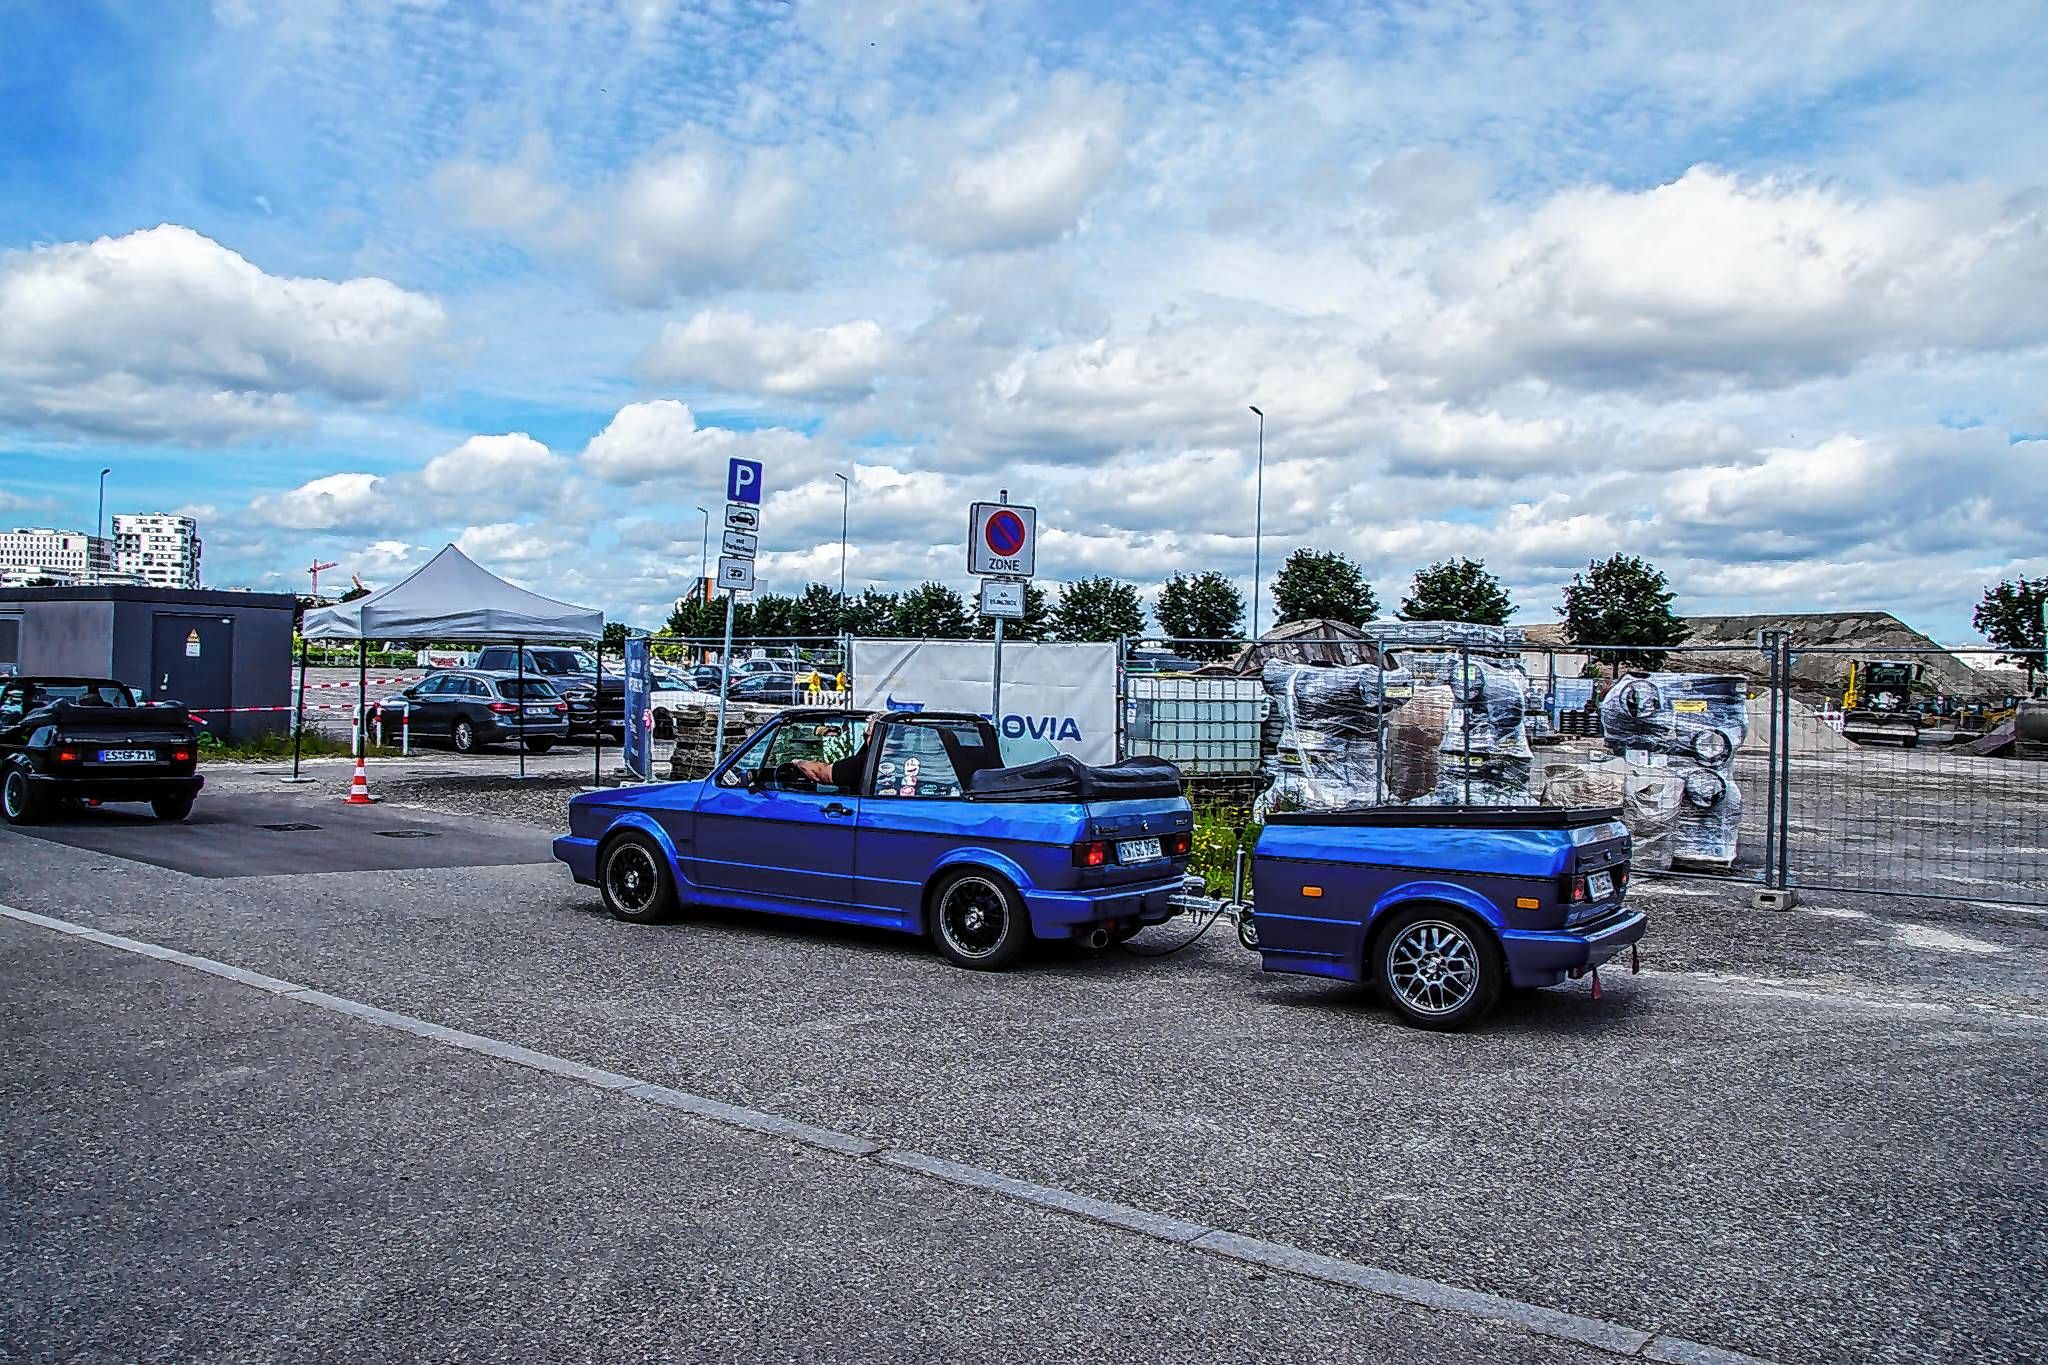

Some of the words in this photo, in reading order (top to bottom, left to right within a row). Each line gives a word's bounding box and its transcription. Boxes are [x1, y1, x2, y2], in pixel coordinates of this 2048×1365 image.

[735, 464, 754, 497] P
[988, 557, 1020, 571] ZONE
[980, 714, 1082, 742] OVIA
